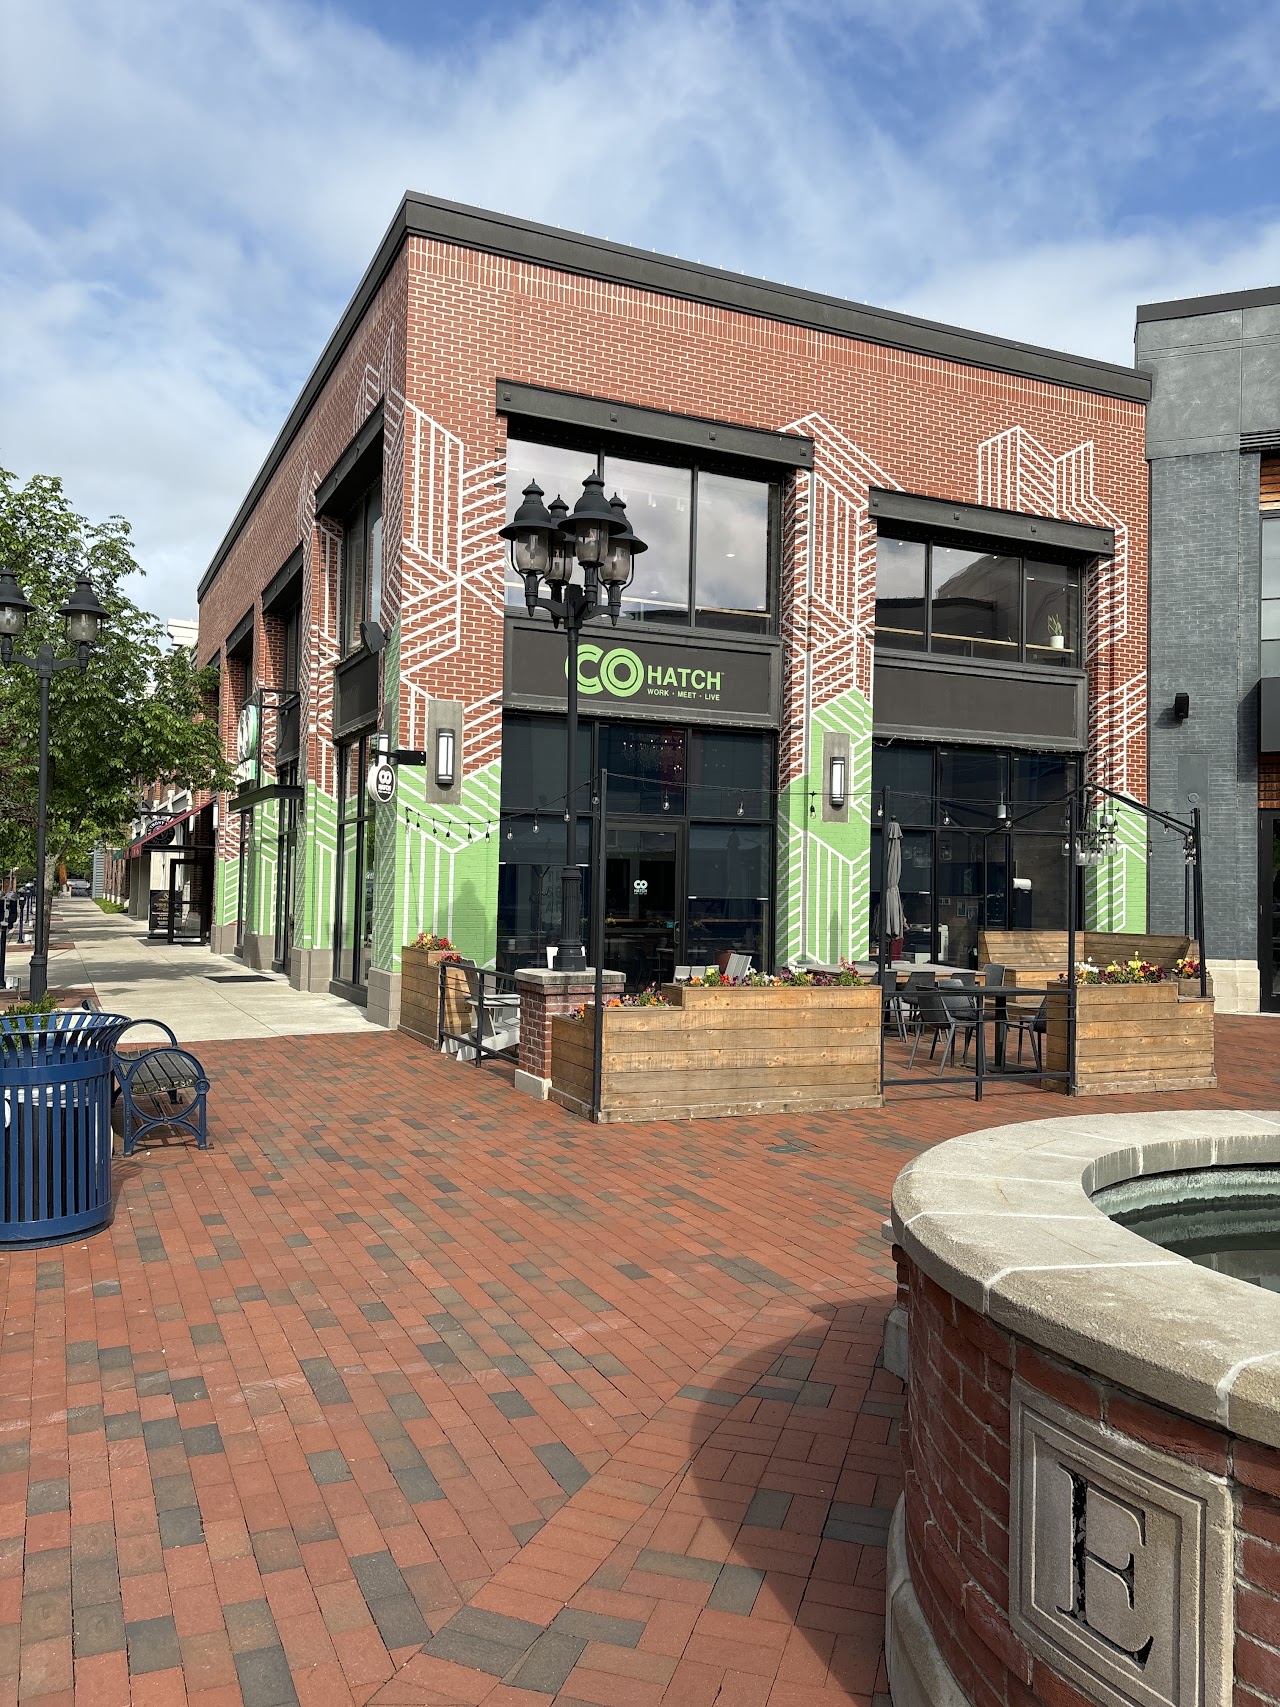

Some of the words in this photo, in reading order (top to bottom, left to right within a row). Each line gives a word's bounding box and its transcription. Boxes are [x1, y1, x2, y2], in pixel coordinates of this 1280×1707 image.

[564, 644, 644, 697] CO
[647, 664, 721, 691] HATCH
[647, 688, 670, 697] WORK
[677, 690, 697, 699] MEET
[704, 693, 720, 701] LIVE
[634, 880, 648, 888] CO
[1055, 1462, 1154, 1672] E
